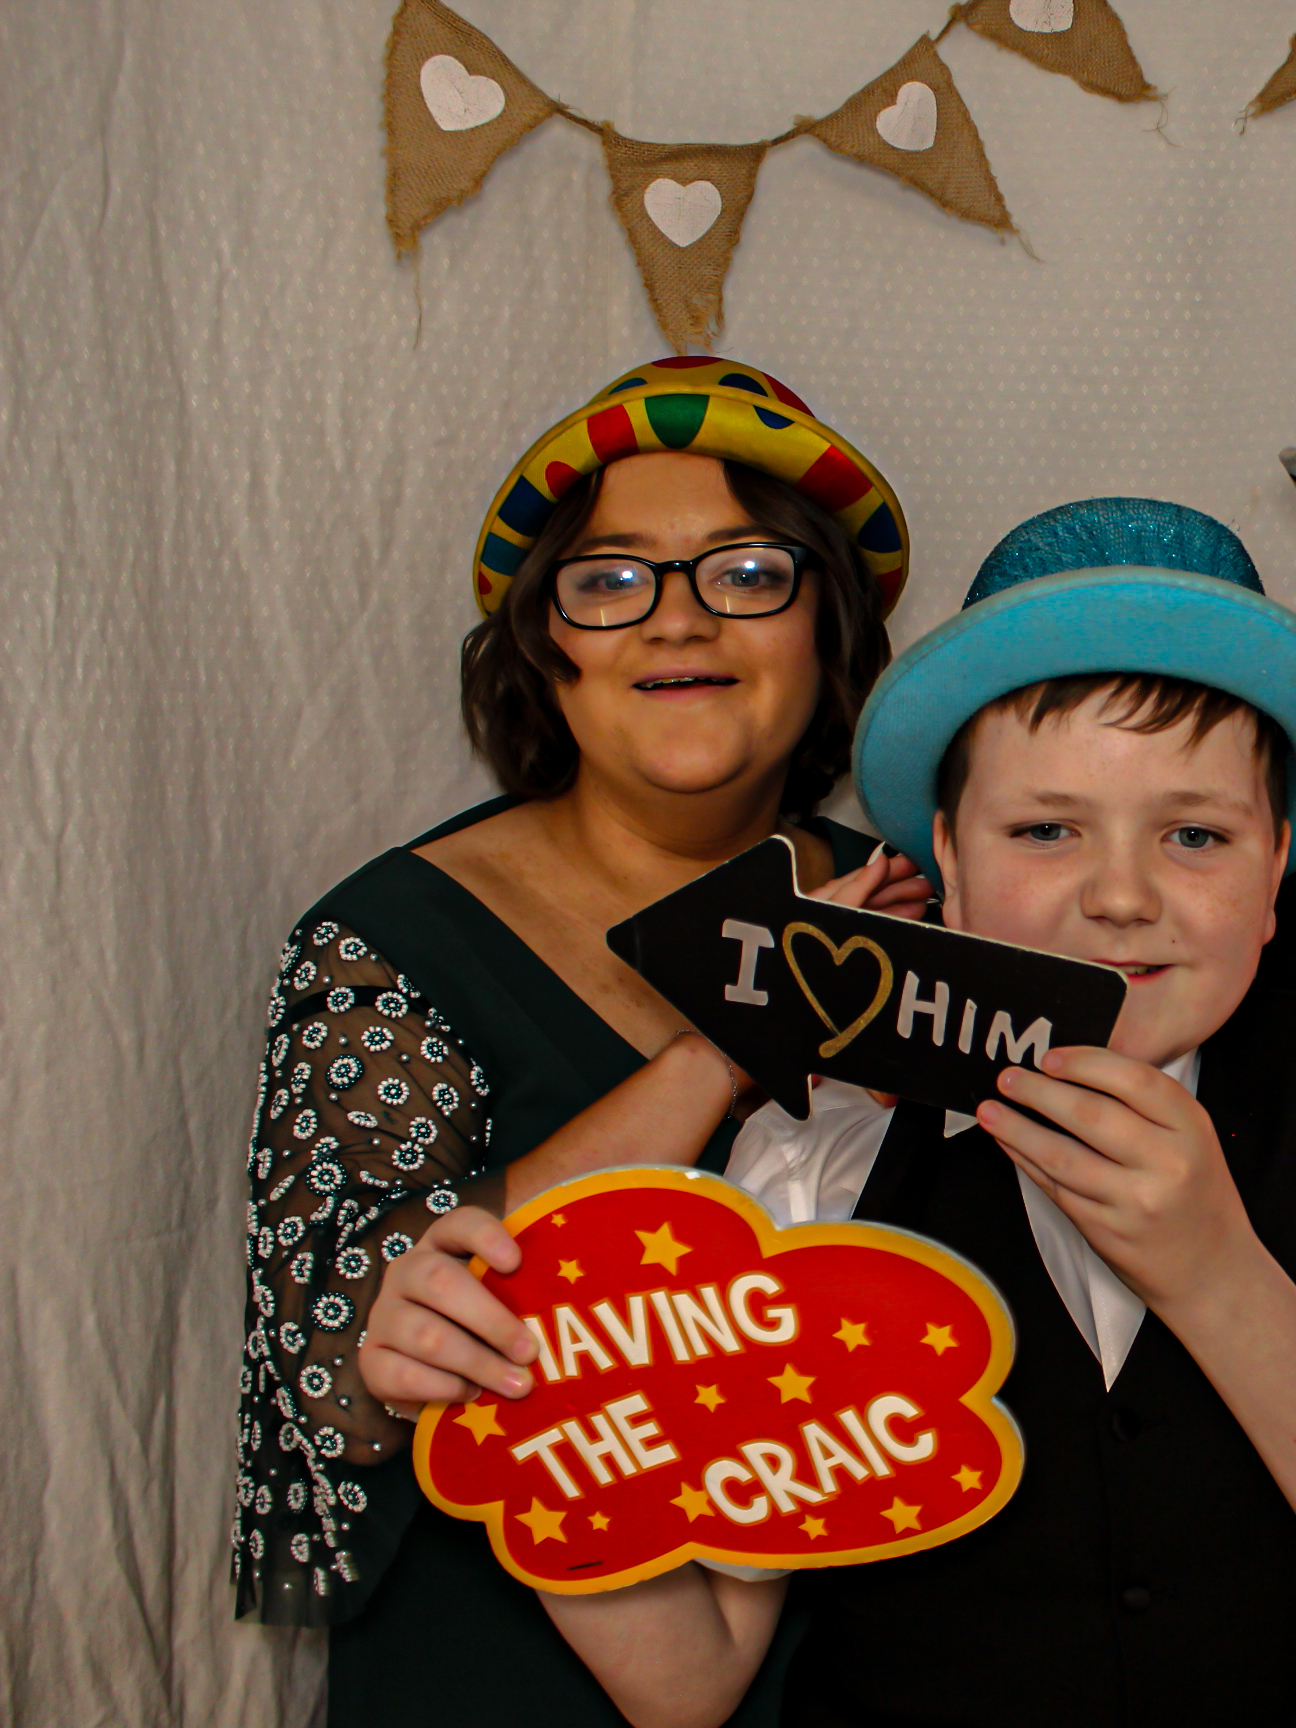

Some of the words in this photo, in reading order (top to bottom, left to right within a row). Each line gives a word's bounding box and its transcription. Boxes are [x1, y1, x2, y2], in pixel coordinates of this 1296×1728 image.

[721, 918, 776, 1007] I
[896, 970, 1054, 1071] HIM
[512, 1394, 678, 1499] THE
[704, 1395, 936, 1524] CRAIC
